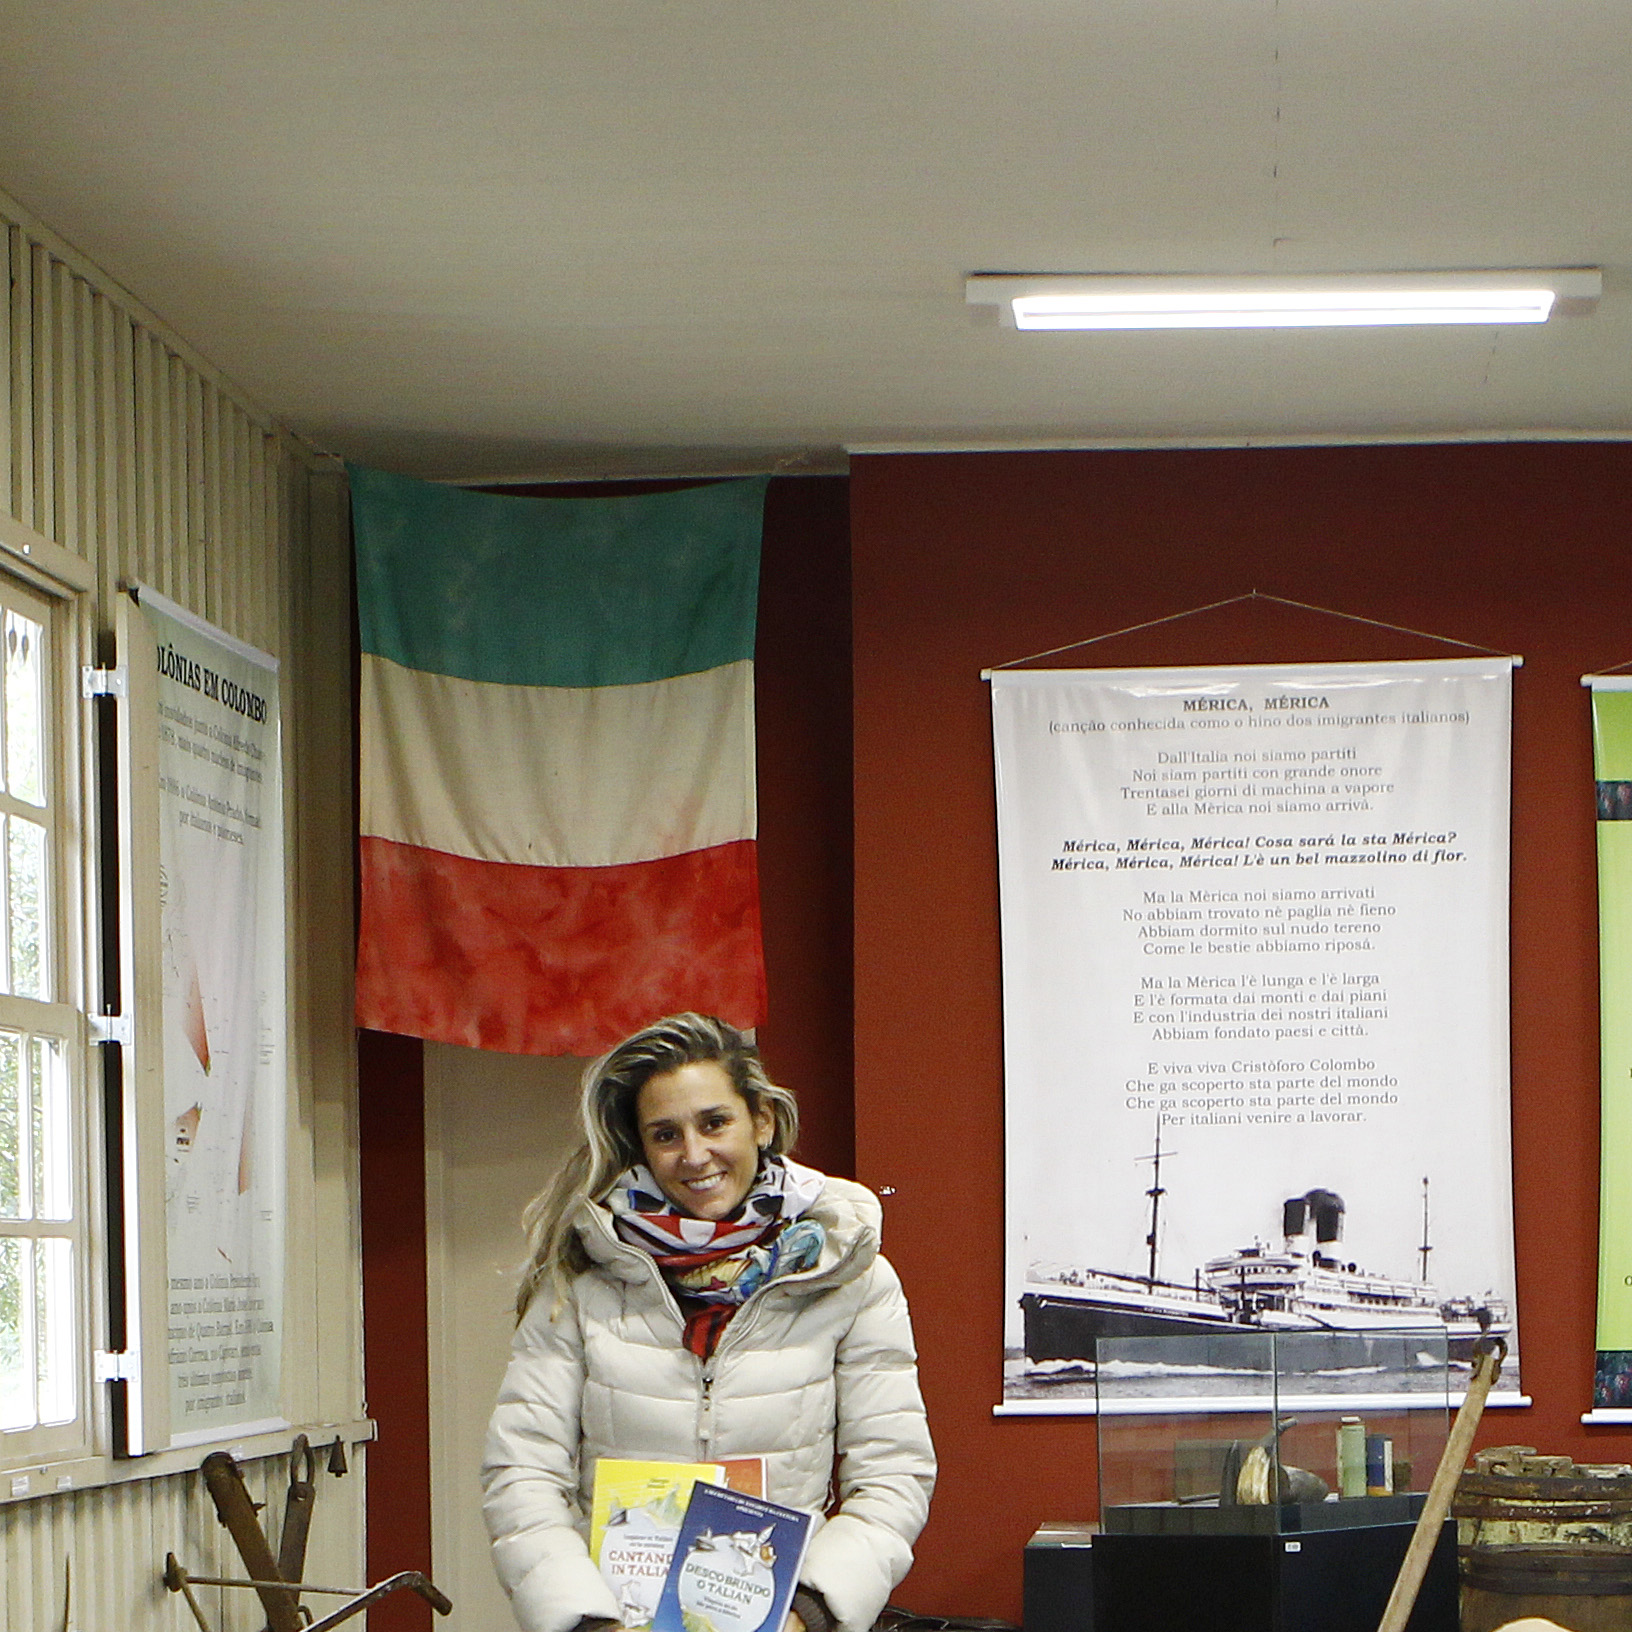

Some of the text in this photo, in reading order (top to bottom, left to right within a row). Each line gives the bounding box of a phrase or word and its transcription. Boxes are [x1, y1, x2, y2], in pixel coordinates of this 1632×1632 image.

[204, 668, 218, 700] EM
[222, 678, 267, 725] COLOMBO
[1182, 693, 1329, 712] MÉRICA, MÉRICA
[1157, 745, 1356, 764] Dall'Italia noi siamo partiti
[1062, 830, 1457, 853] Mérica, Mérica, Mérica! Cosa sará la sta Mérica?
[685, 1563, 771, 1598] DESCOBRINDO
